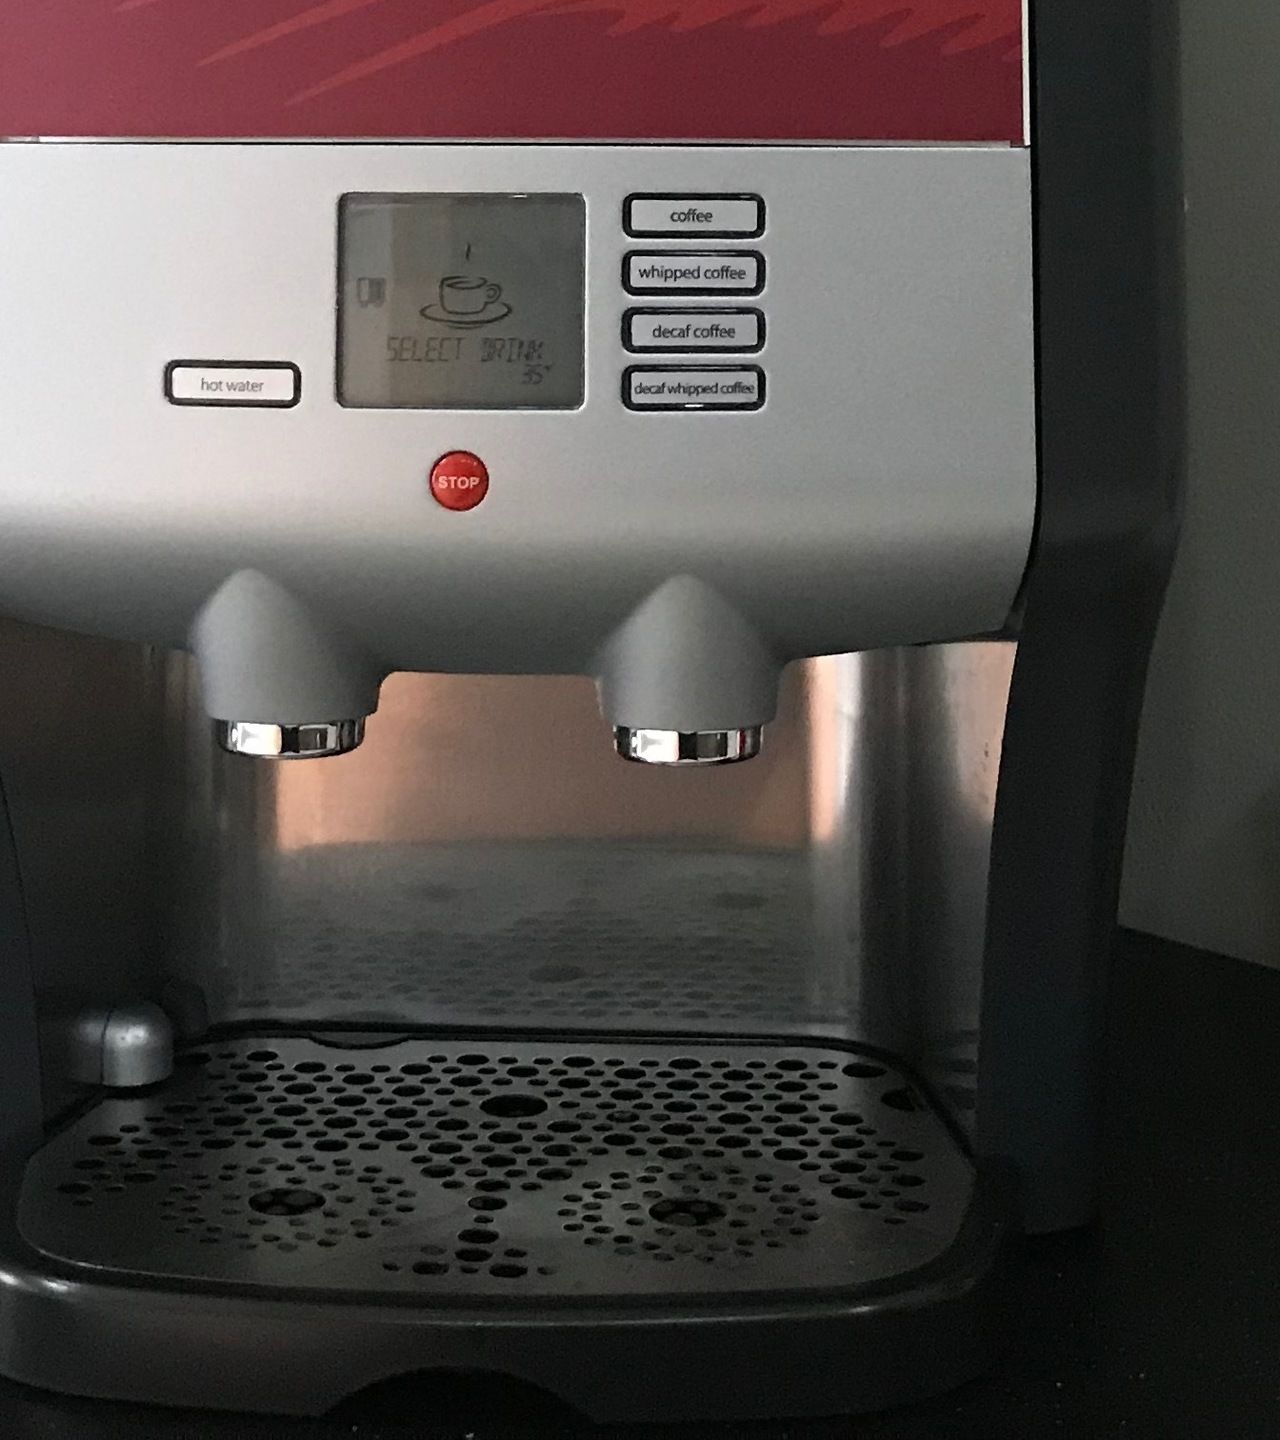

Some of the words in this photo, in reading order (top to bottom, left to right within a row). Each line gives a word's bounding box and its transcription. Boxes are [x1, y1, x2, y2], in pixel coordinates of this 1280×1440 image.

[669, 208, 713, 223] coffee
[638, 265, 701, 282] whipped
[703, 265, 747, 279] coffee
[652, 323, 692, 339] decaf
[693, 323, 736, 339] coffee
[386, 335, 466, 362] SELECT
[200, 377, 223, 391] hot
[226, 379, 265, 392] water
[634, 382, 666, 395] decaf
[667, 382, 719, 397] whipped
[720, 381, 755, 395] coffee
[438, 475, 480, 489] STOP
